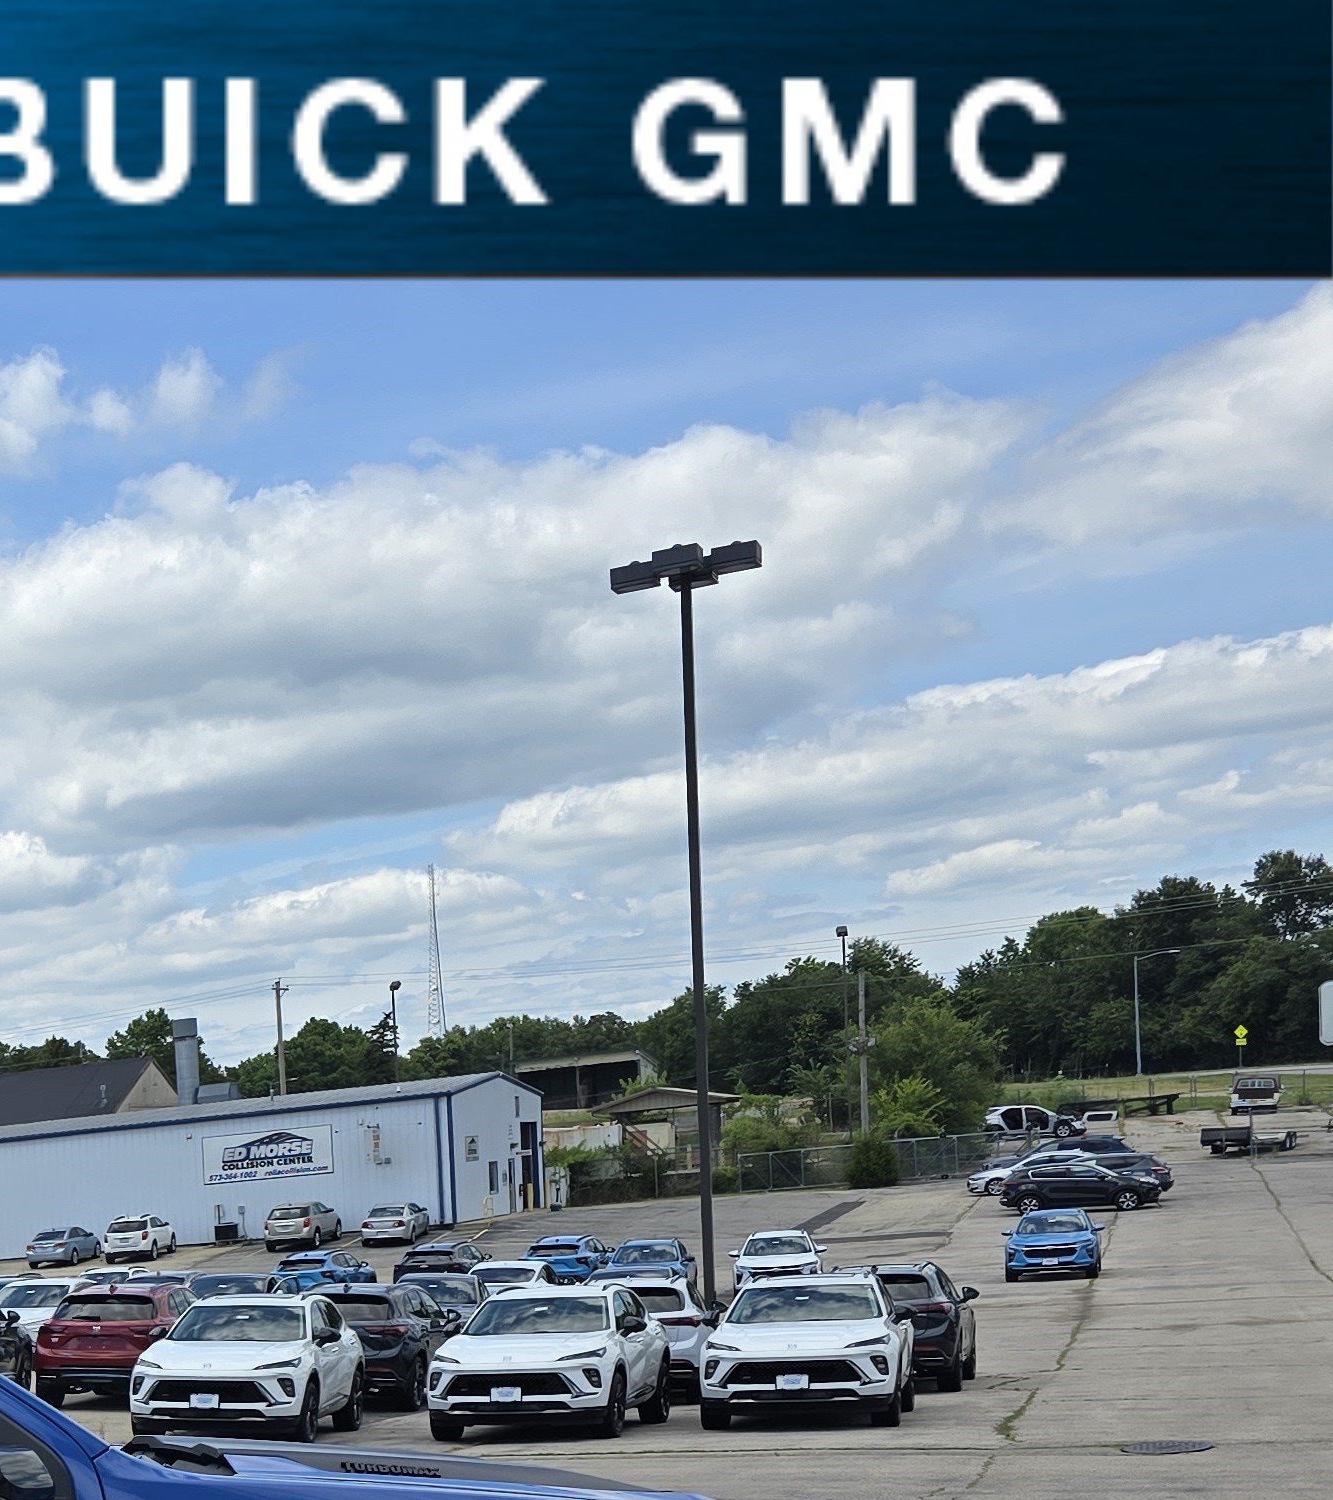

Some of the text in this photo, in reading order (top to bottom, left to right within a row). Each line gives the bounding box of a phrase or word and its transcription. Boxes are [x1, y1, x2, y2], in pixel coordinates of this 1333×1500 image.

[222, 1139, 313, 1163] ED MORSE
[222, 1155, 314, 1171] COLLISION CENTER
[340, 1461, 442, 1478] TURBOMAX
